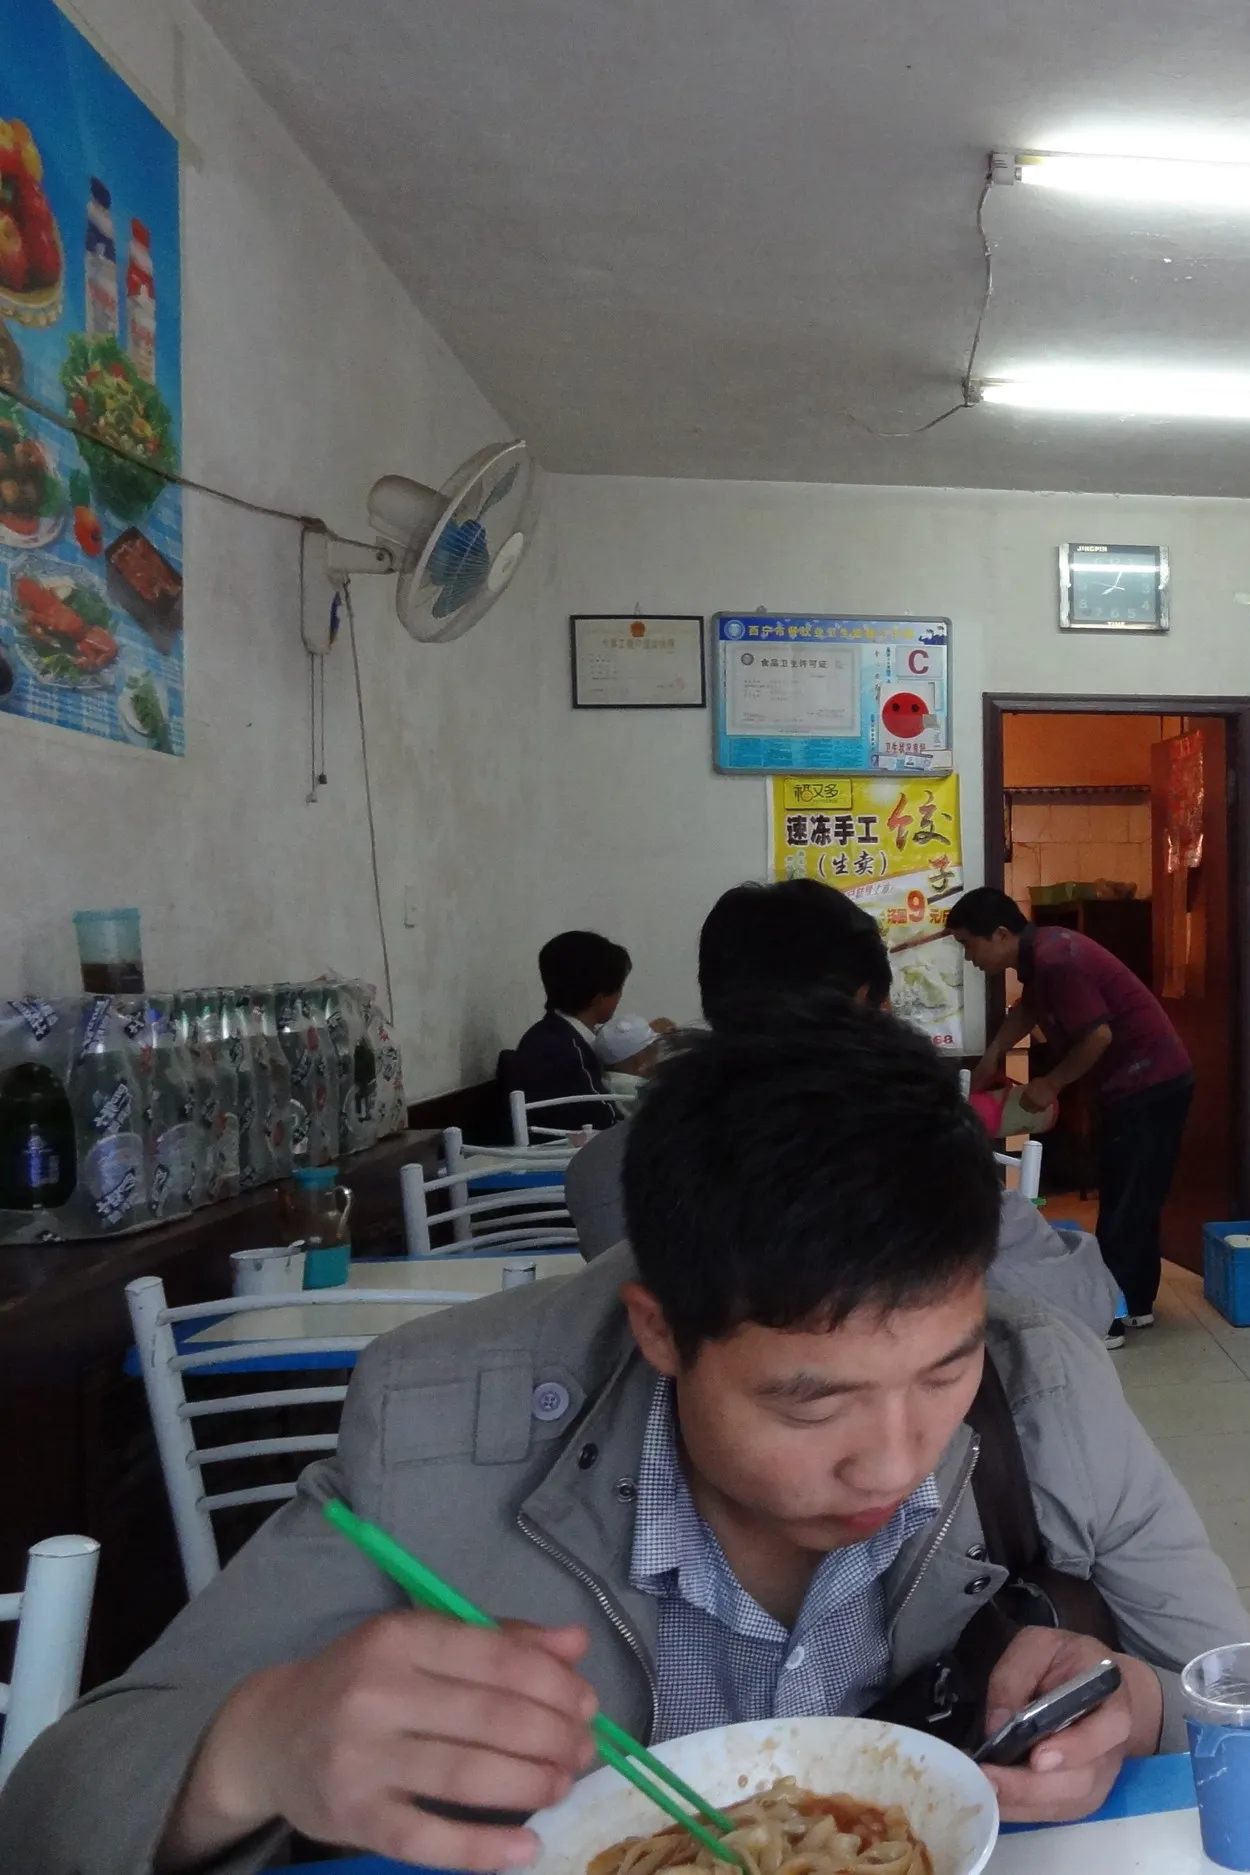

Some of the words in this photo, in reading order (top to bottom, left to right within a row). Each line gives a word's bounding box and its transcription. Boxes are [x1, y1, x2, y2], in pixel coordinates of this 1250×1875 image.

[761, 658, 828, 669] 食品卫生许可证
[908, 649, 929, 675] C
[786, 815, 878, 846] 速冻手工
[929, 1035, 953, 1044] 68
